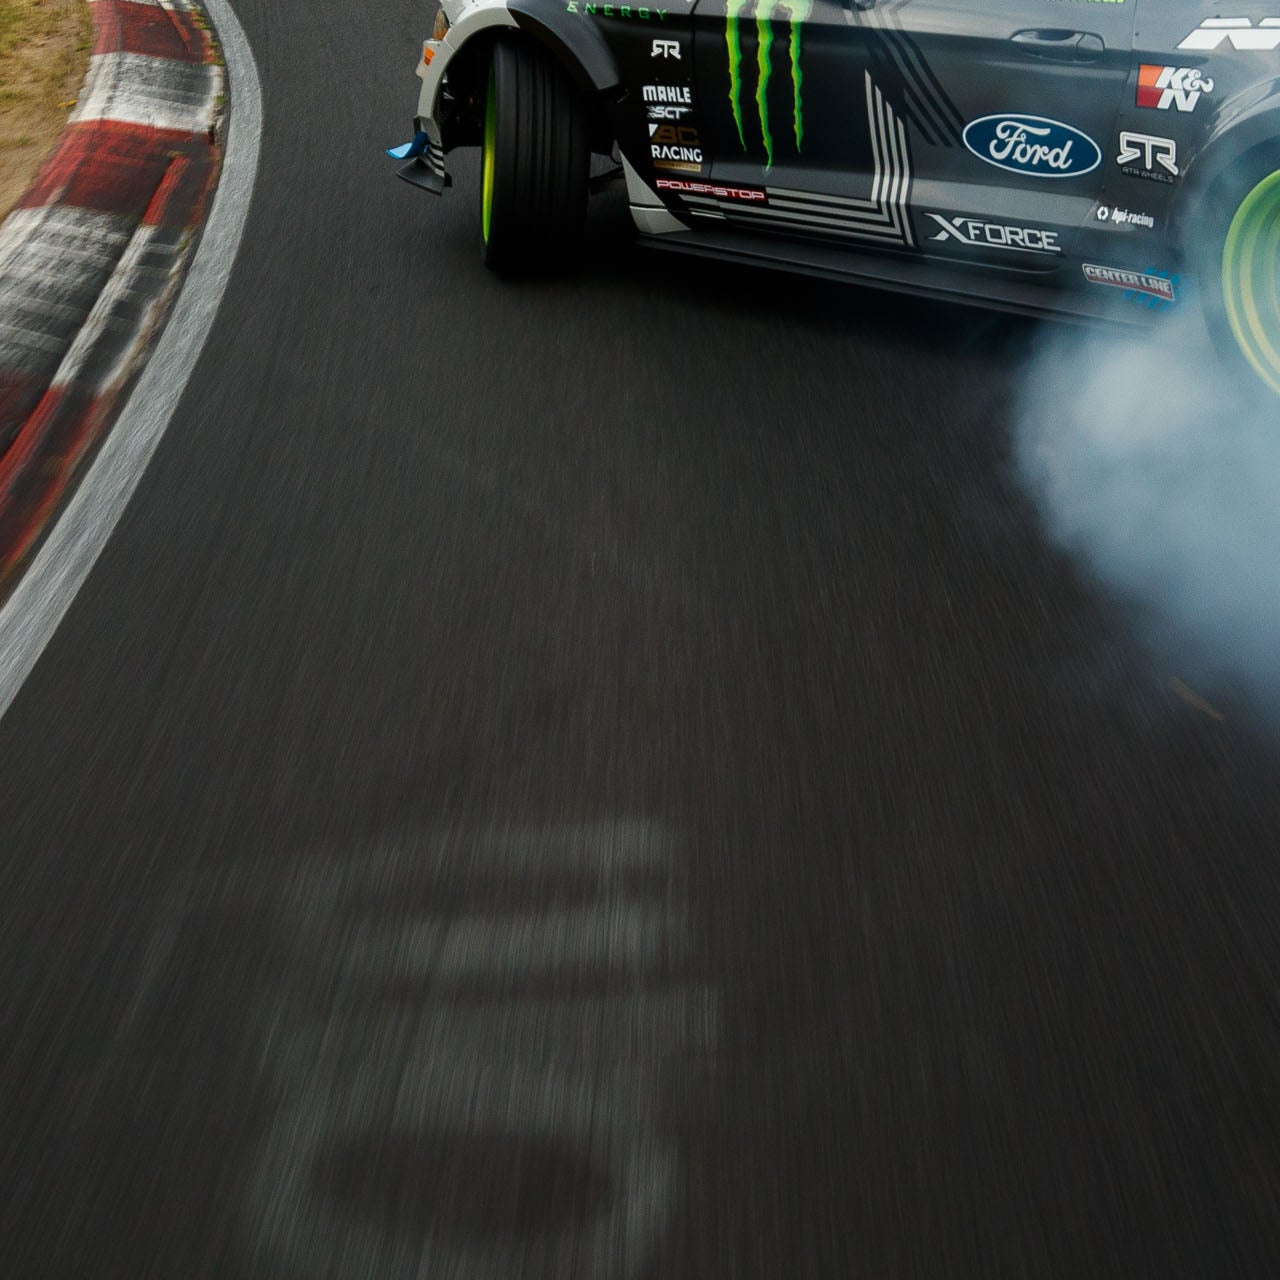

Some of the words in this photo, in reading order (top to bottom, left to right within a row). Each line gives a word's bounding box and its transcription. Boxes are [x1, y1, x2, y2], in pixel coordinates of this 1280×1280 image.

[567, 0, 668, 21] ENERGY
[642, 85, 692, 104] MAHLE
[652, 106, 689, 120] SCT
[650, 145, 703, 163] RACING
[988, 120, 1074, 170] Ford
[1141, 171, 1174, 184] WHEELS
[1085, 266, 1139, 287] CENTER
[1141, 277, 1171, 293] LINE
